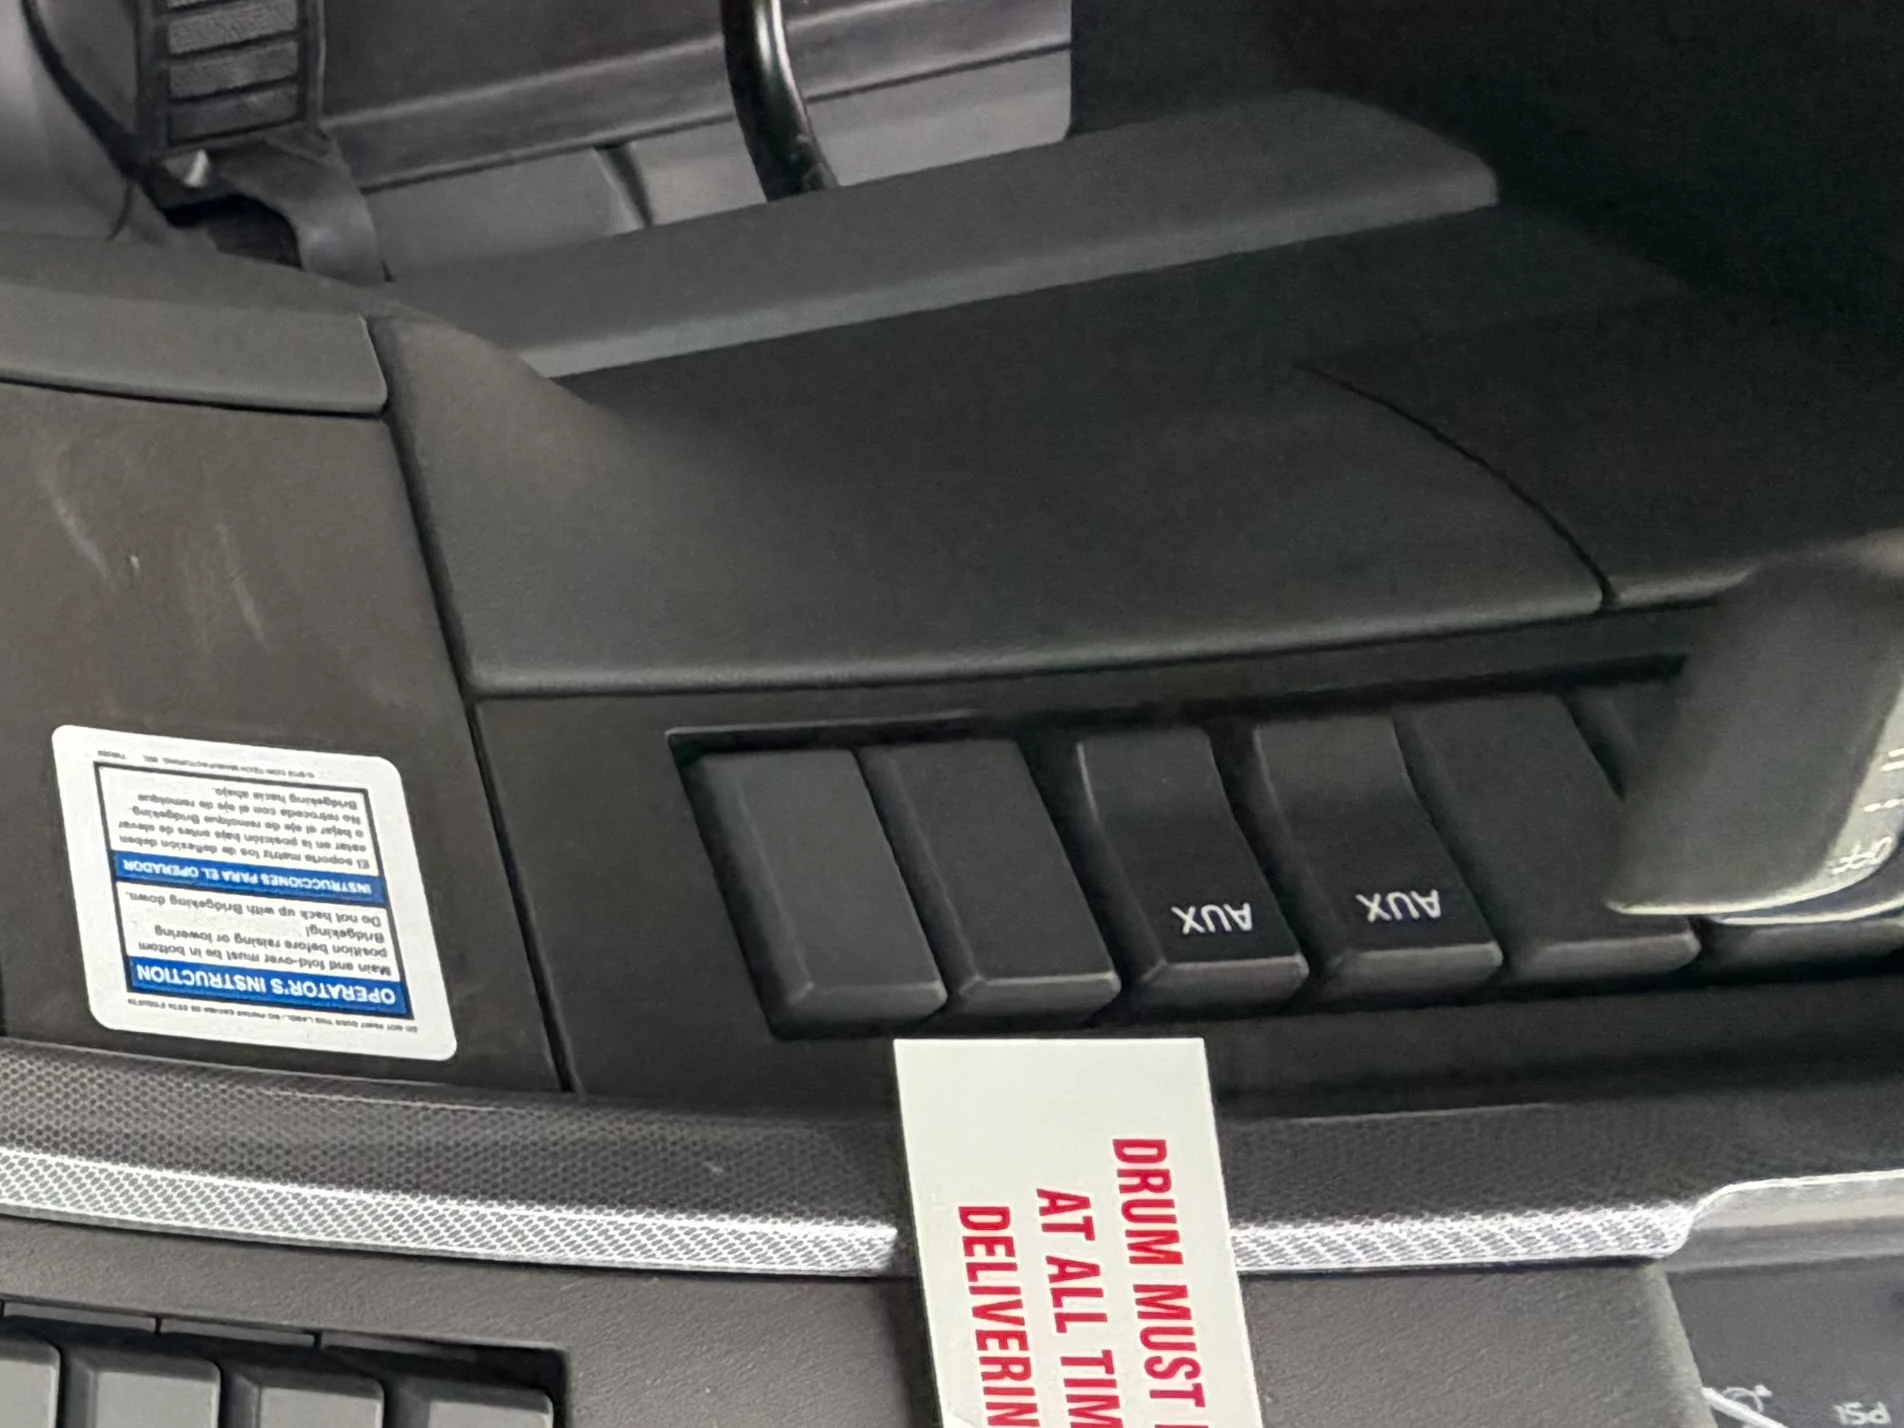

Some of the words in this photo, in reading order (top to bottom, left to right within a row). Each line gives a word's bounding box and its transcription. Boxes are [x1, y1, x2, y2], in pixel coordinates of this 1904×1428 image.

[123, 858, 199, 879] OPERADOR
[201, 866, 219, 881] EL
[221, 868, 258, 885] PARA
[261, 872, 373, 896] INSTRUCCIONES
[246, 905, 276, 918] with
[278, 906, 296, 918] up
[1354, 889, 1442, 923] AUX
[300, 910, 333, 924] back
[336, 914, 360, 927] not
[362, 917, 383, 929] Do
[1170, 902, 1253, 935] AUX
[155, 926, 213, 944] lowering
[216, 933, 231, 943] or
[234, 933, 281, 951] raising
[138, 942, 186, 957] bottom
[189, 947, 203, 959] in
[205, 949, 223, 961] be
[284, 940, 329, 956] before
[331, 943, 389, 962] position
[226, 951, 261, 965] must
[264, 955, 326, 971] fold-over
[329, 961, 355, 974] and
[358, 964, 393, 978] Main
[136, 964, 267, 993] INSTRUCTION
[270, 977, 398, 1007] OPERATOR'S
[1111, 1138, 1184, 1266] DRUM
[1035, 1188, 1096, 1242] AT
[1044, 1254, 1108, 1333] ALL
[1133, 1284, 1206, 1409] MUST
[1834, 1400, 1892, 1426] PSI
